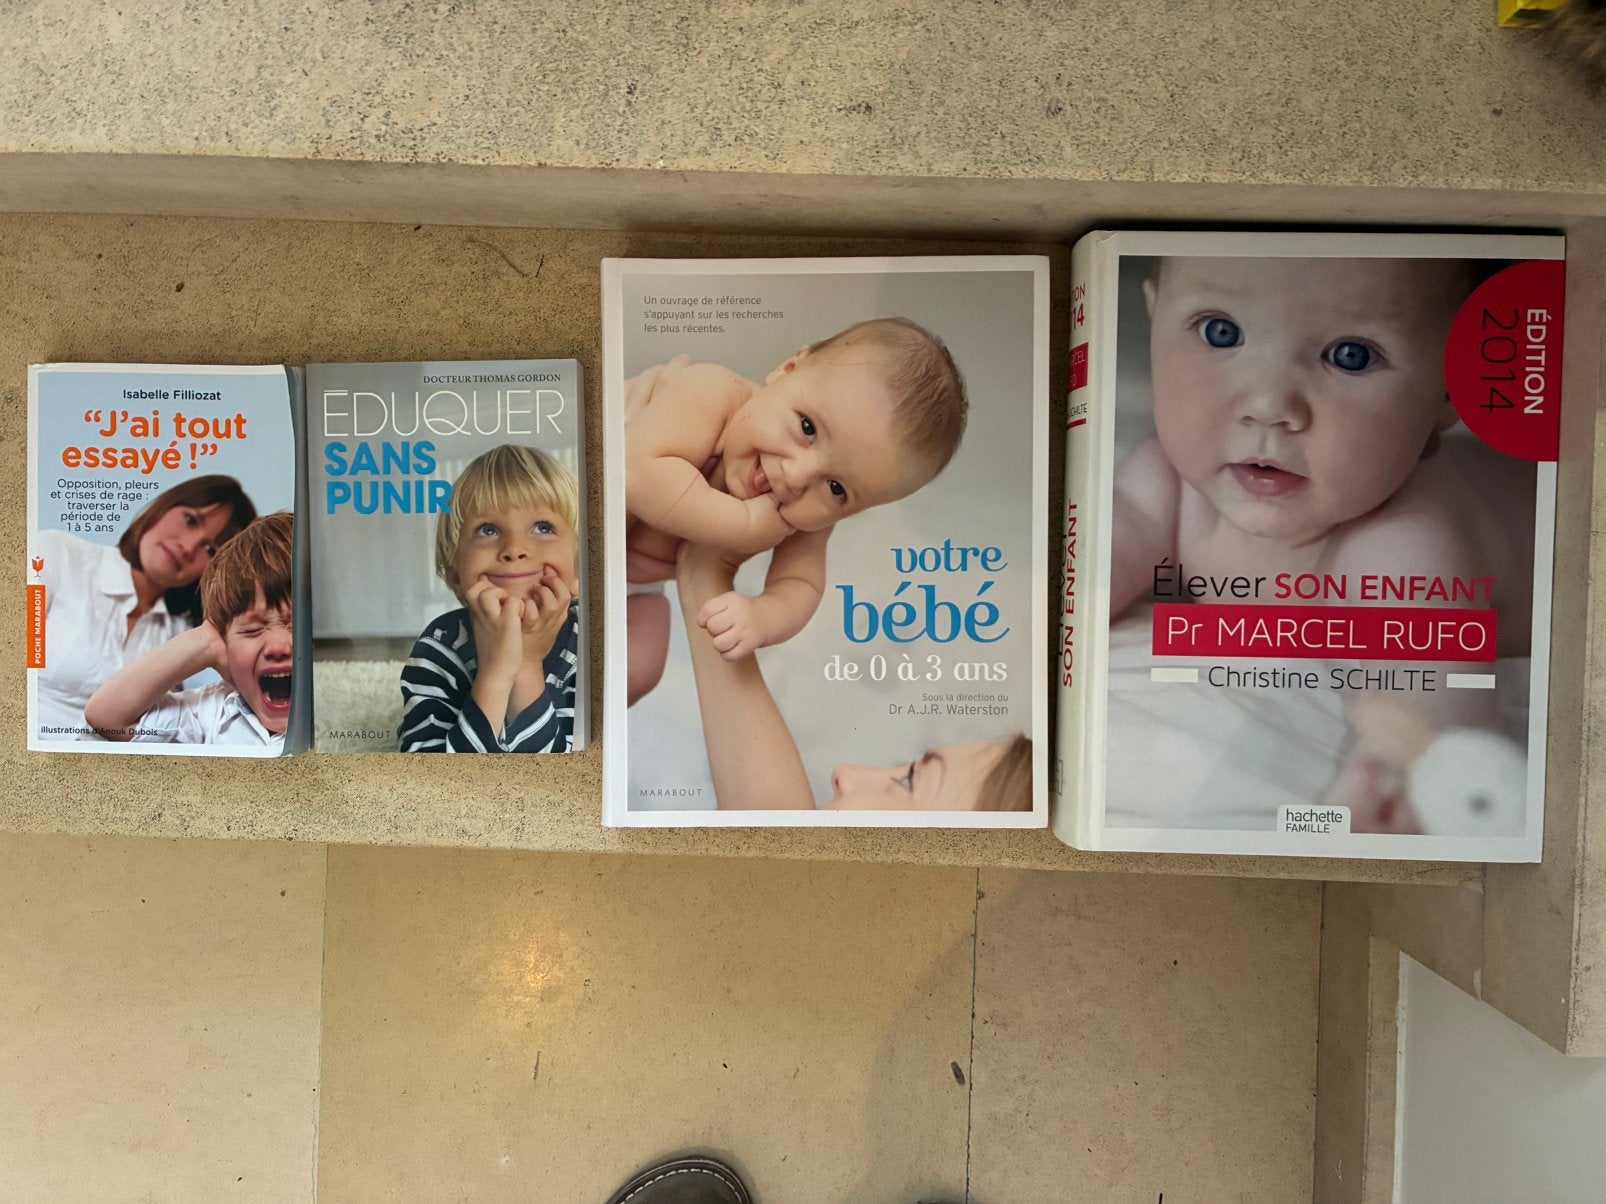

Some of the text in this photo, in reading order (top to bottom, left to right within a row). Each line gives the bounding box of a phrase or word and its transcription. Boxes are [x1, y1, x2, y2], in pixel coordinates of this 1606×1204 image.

[644, 296, 762, 307] Un ouvrage de référence
[698, 311, 712, 319] sur
[716, 310, 729, 319] les
[732, 310, 784, 319] recherches
[644, 324, 726, 334] les plus récentes.
[1479, 308, 1519, 413] 2014
[1524, 309, 1552, 414] ÉDITION
[423, 374, 561, 384] DOCTEUR THOMAS GORDON
[123, 389, 221, 401] Isabelle Filliozat
[173, 412, 247, 439] tout
[324, 440, 436, 476] SANS
[57, 479, 159, 491] Opposition, pleurs
[50, 491, 61, 499] et
[65, 490, 96, 499] crises
[99, 490, 114, 500] de
[117, 492, 143, 501] rage
[326, 480, 453, 515] PUNIR
[67, 502, 129, 510] traverser la
[60, 511, 121, 523] période de
[66, 523, 71, 532] 1
[75, 523, 82, 532] à
[84, 523, 92, 532] 5
[890, 538, 1008, 573] votre
[1153, 558, 1498, 602] Élever SON ENFANT
[1063, 500, 1078, 688] SON ENFANT
[835, 581, 1010, 643] bébé
[34, 588, 42, 664] POCHE MARABOUT
[1167, 616, 1486, 651] Pr MARCEL RUFO
[824, 653, 1007, 681] de 0 à 3 ans
[1208, 666, 1436, 691] Christine SCHILTE
[922, 693, 1009, 701] Sous la direction du
[889, 704, 1008, 715] Dr A.J.R. Waterston
[40, 726, 90, 734] illustrations
[329, 730, 391, 740] MARABOUT
[640, 788, 702, 797] MARABOUT
[1286, 808, 1343, 822] hachette
[1286, 823, 1330, 833] FAMILLE
